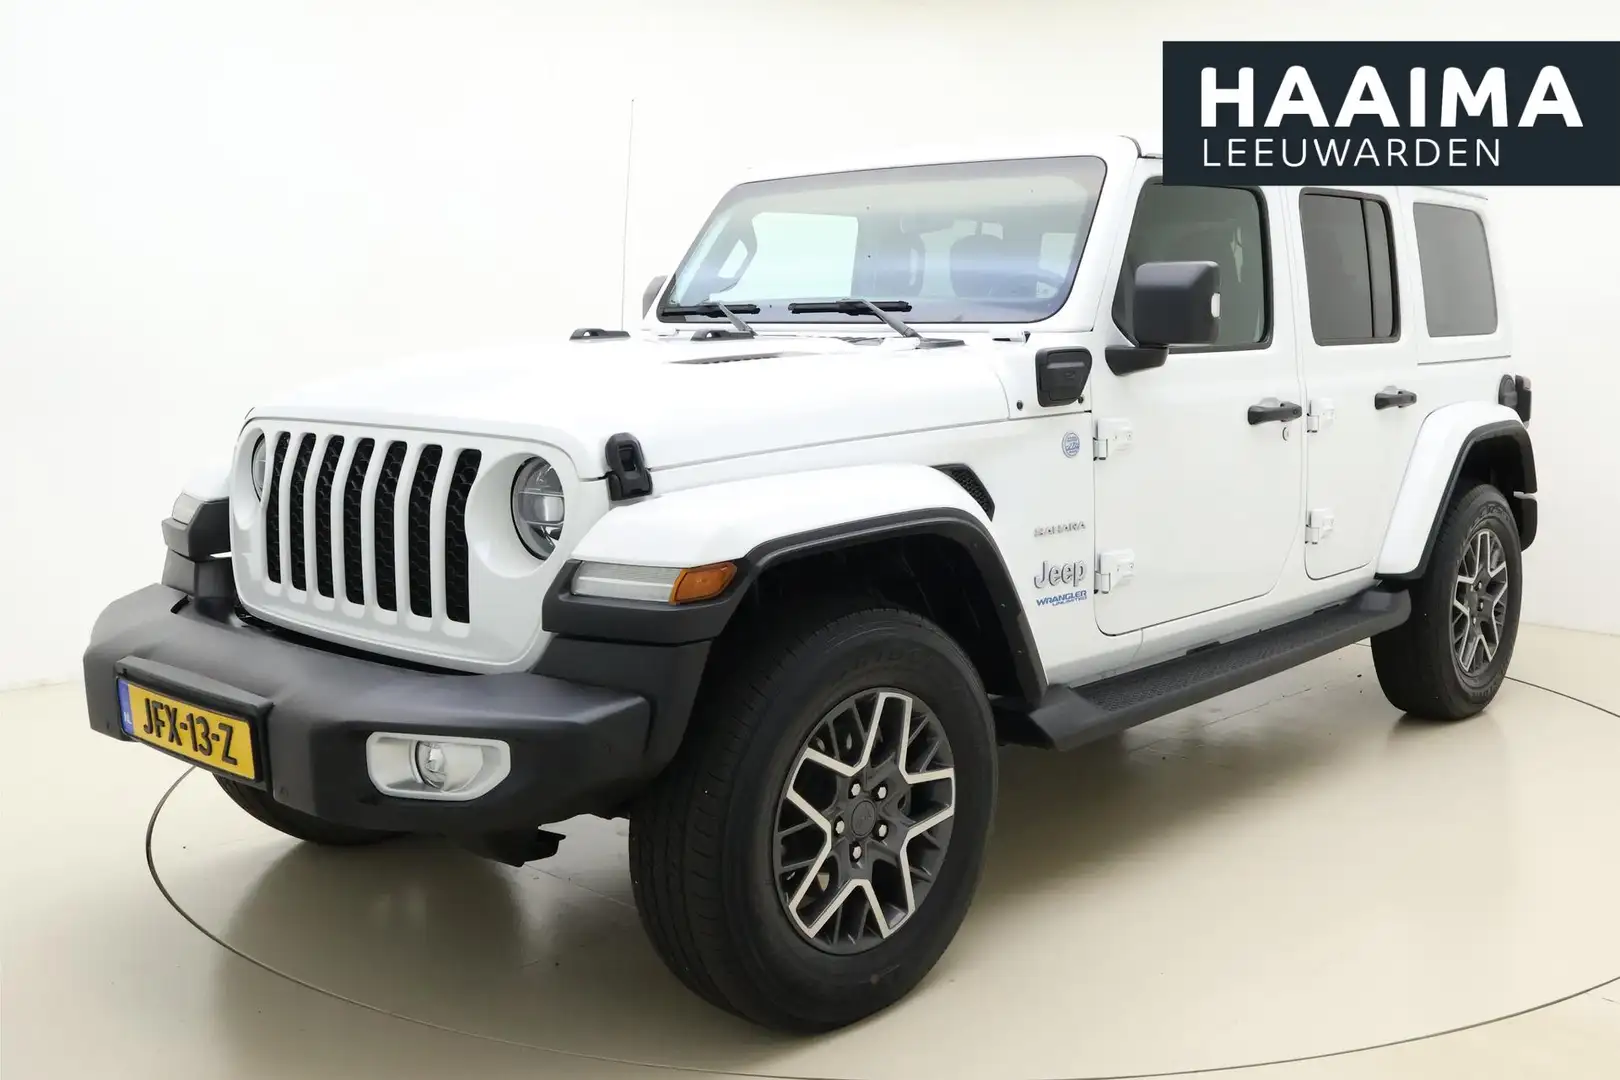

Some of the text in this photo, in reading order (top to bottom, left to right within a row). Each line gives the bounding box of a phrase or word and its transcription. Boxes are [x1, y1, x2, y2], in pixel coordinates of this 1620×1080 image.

[1033, 560, 1087, 588] Jeep
[1036, 590, 1087, 606] WRANGLER
[143, 698, 238, 766] JFX-13-Z
